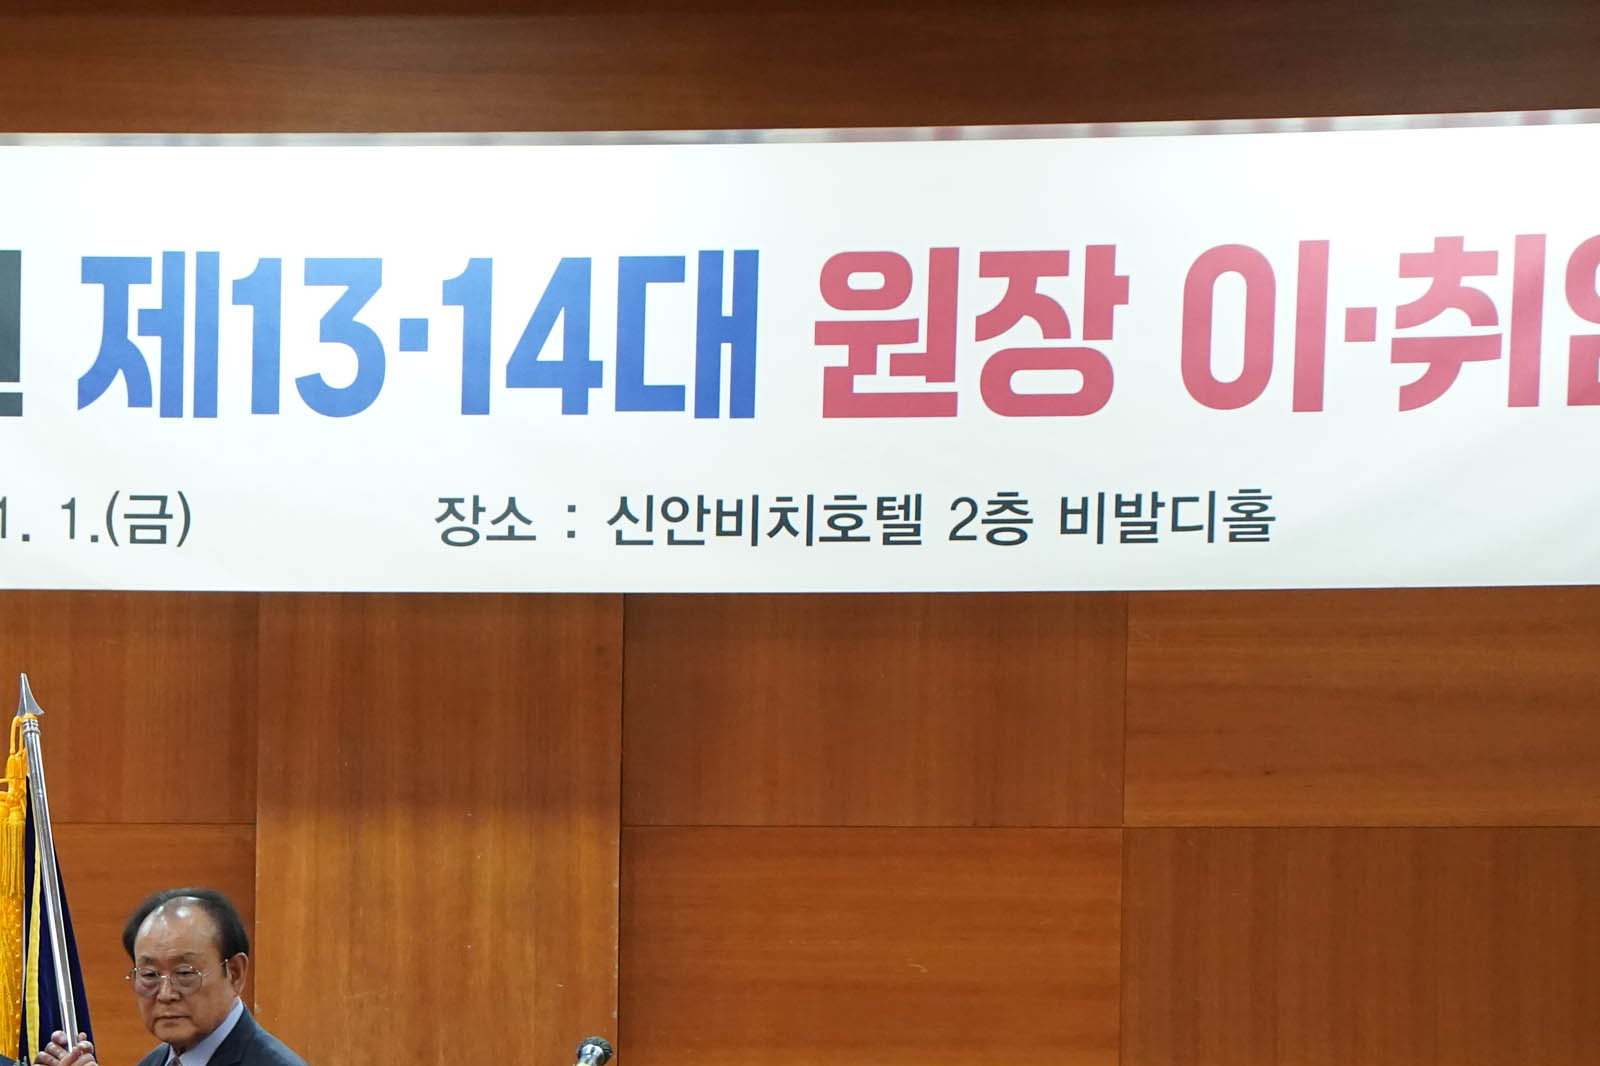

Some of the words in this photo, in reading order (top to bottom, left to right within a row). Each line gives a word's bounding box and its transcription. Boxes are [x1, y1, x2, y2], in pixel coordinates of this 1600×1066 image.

[814, 244, 1130, 419] 원장
[434, 493, 537, 547] 장소
[606, 492, 924, 549] 신안비치호텔
[948, 491, 1035, 546] 2층
[1059, 487, 1280, 546] 비발디홀
